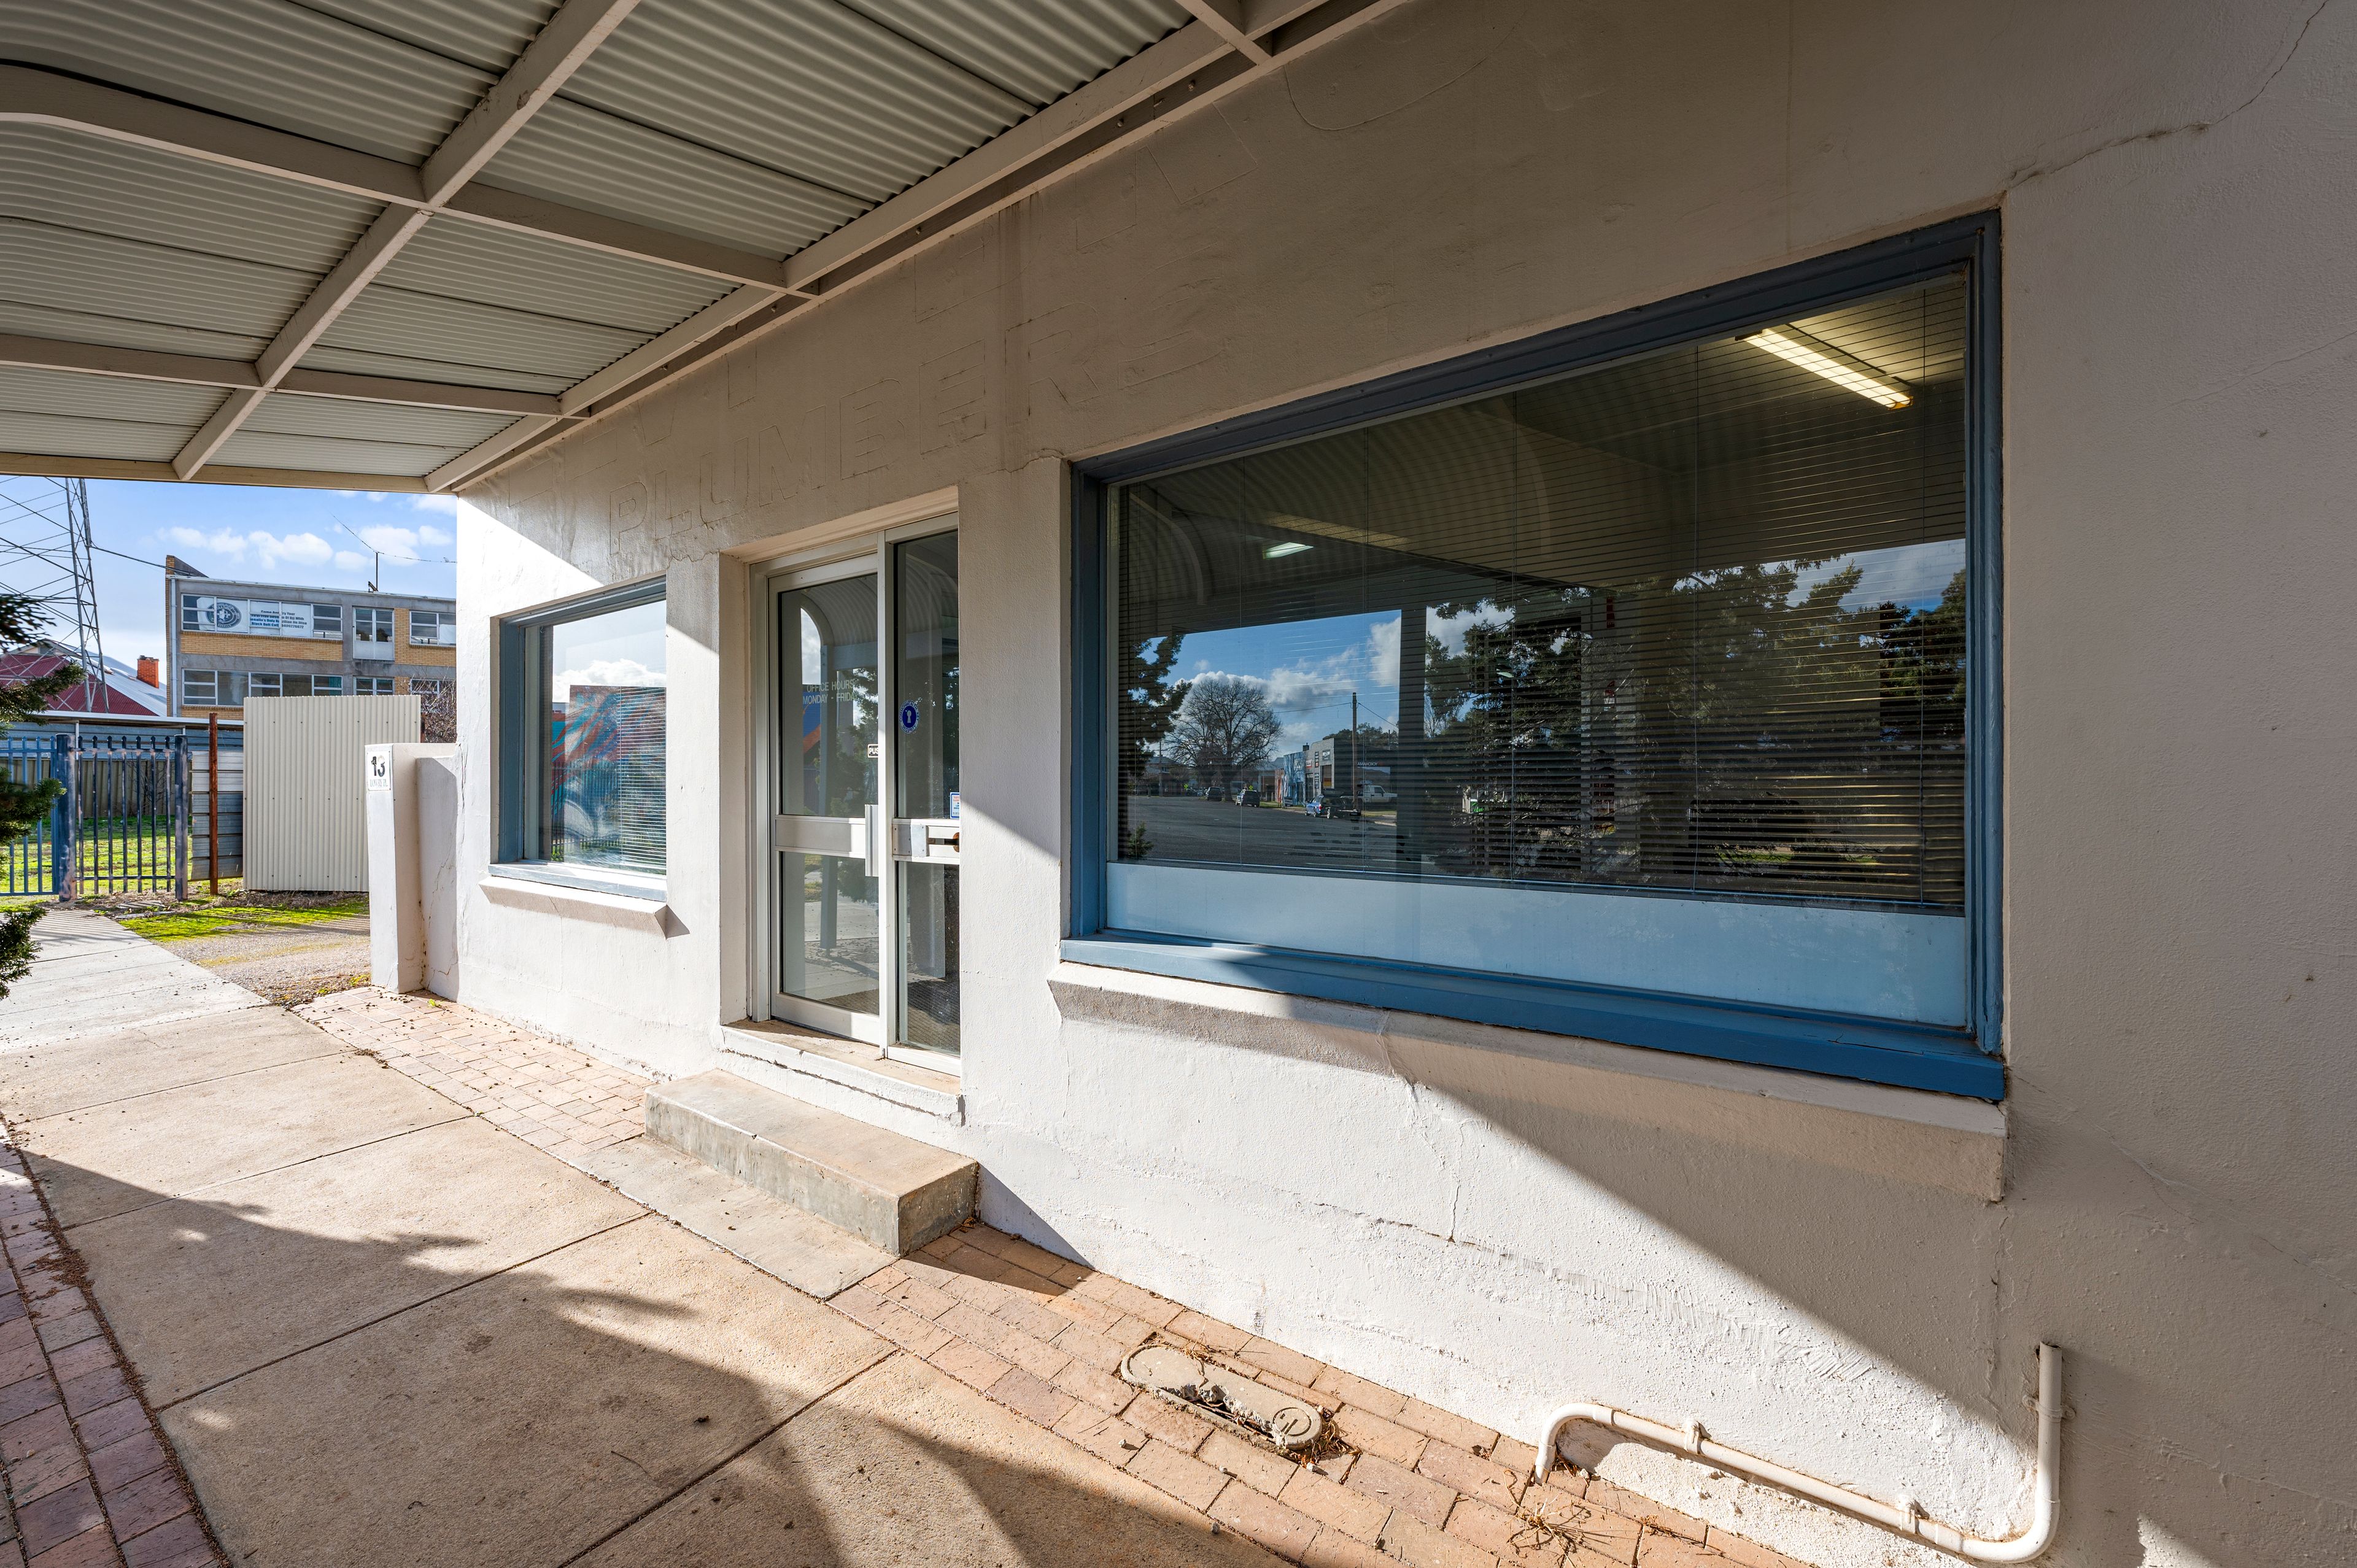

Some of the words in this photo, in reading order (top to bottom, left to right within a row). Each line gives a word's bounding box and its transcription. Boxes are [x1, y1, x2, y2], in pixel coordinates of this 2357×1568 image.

[807, 682, 829, 692] OFFICE
[802, 694, 828, 705] MONDAY
[837, 692, 858, 702] FRIDAY
